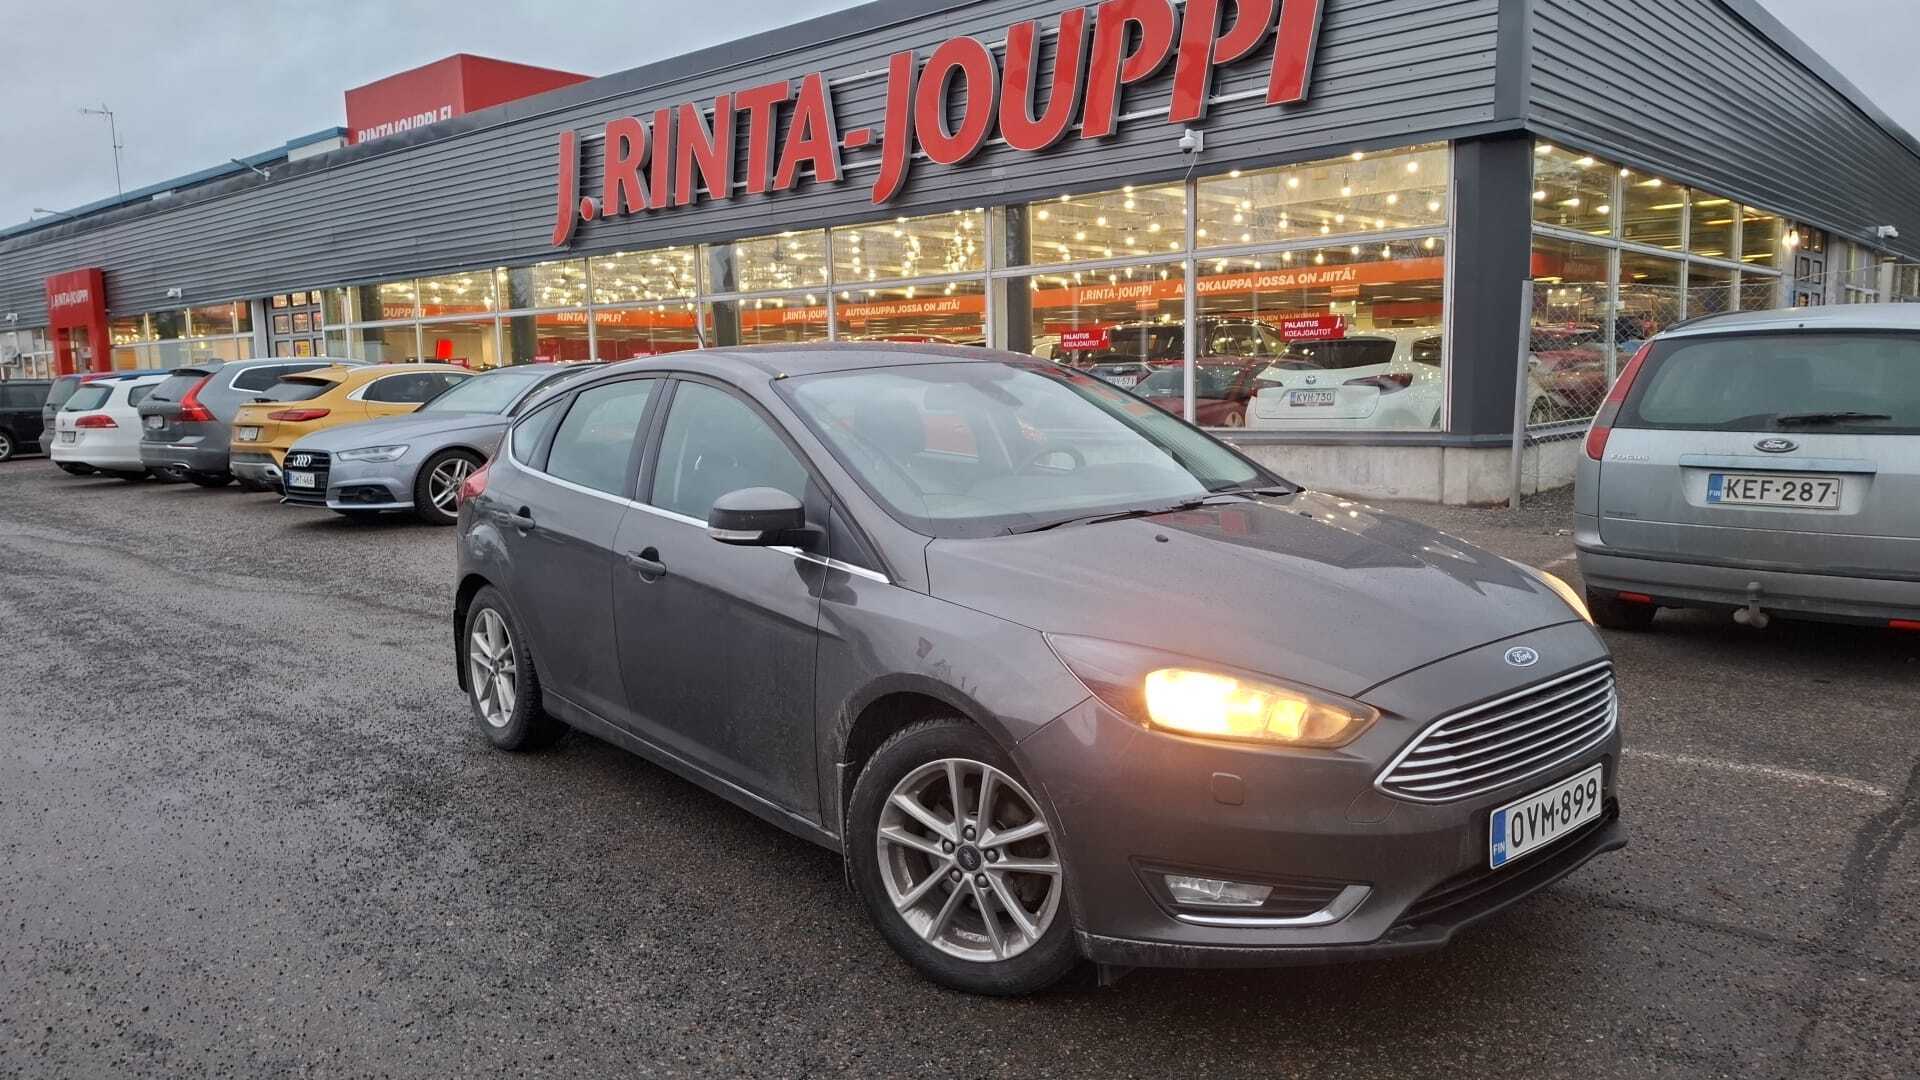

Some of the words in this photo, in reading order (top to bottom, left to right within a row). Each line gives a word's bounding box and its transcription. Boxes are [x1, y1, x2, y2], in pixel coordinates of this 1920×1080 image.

[1175, 278, 1252, 294] AOKAUPPA
[1256, 274, 1295, 287] JOSSA
[1298, 272, 1317, 284] ON
[783, 309, 829, 323] J.RINTA-JOUPP
[898, 303, 922, 314] JOSSA
[924, 302, 936, 312] ON
[1285, 320, 1319, 329] PALAUTUS
[1285, 329, 1331, 337] KOEAJOAUTOT
[1725, 477, 1833, 504] KEF-287
[1493, 840, 1506, 857] FIN
[1511, 777, 1598, 848] OVM-899
